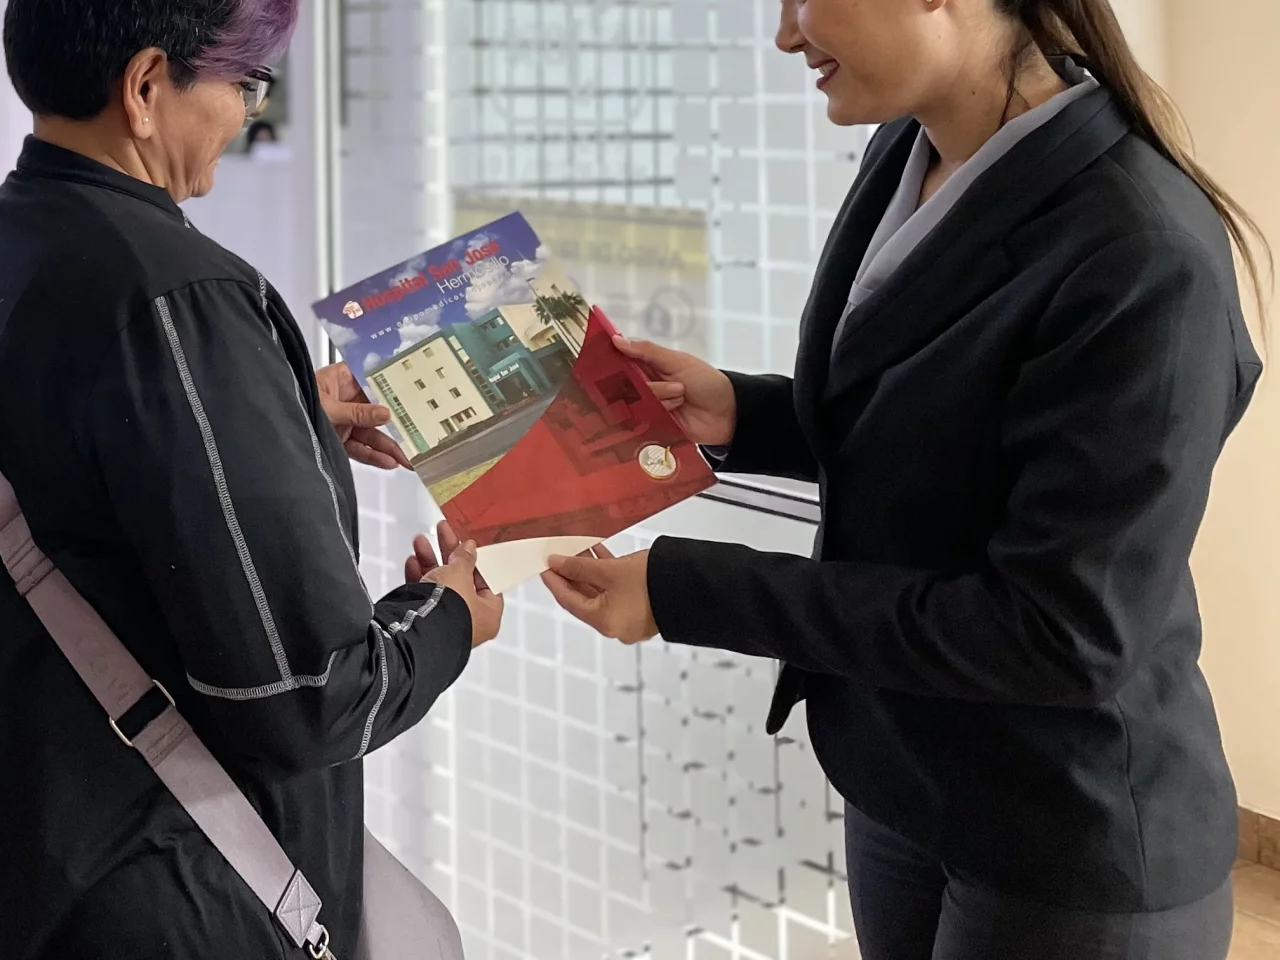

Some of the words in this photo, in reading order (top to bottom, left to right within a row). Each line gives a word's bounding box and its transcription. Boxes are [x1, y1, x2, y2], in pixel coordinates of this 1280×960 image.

[362, 270, 429, 311] Hospital
[427, 258, 463, 282] San
[436, 254, 510, 294] Hermosillo
